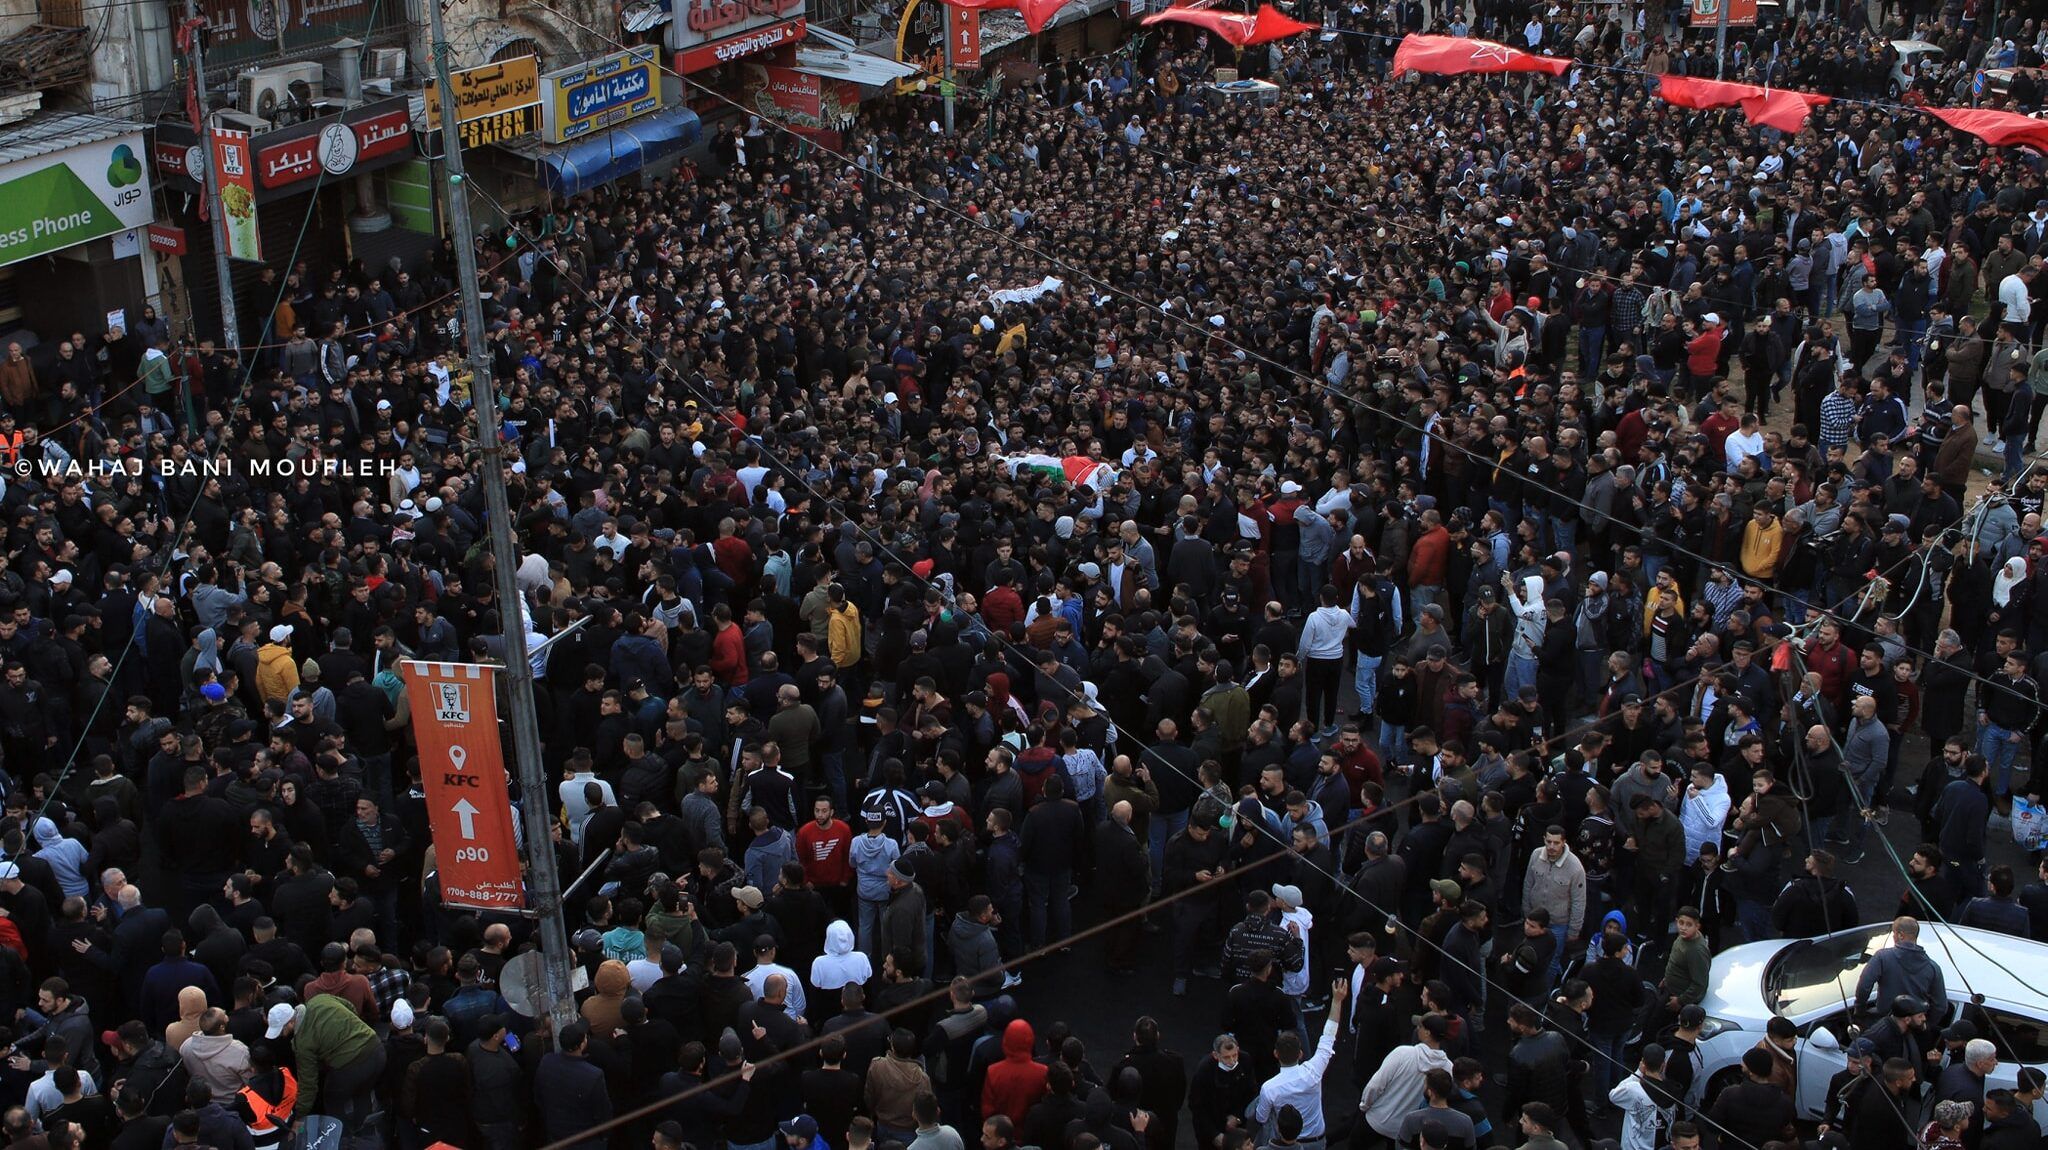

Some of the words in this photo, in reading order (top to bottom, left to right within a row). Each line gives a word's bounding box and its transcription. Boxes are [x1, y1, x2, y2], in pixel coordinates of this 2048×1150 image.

[759, 27, 783, 49] للتجارة
[460, 64, 504, 89] شركة
[512, 76, 535, 97] المركز
[612, 71, 645, 100] مكتبة
[772, 81, 788, 93] زمان
[490, 82, 513, 107] العالمي
[573, 83, 611, 117] المأمون
[459, 108, 525, 138] ESTERN
[362, 123, 409, 150] مستر
[468, 122, 525, 149] UNION
[226, 165, 242, 174] KFC
[269, 150, 313, 178] بيكر
[113, 188, 142, 207] جوال
[0, 228, 28, 248] ess
[32, 210, 92, 239] Phone
[441, 711, 465, 720] KFC
[443, 773, 480, 788] KFC
[446, 887, 518, 902] 1700-888-777
[475, 881, 492, 890] على
[493, 880, 516, 890] أطلب
